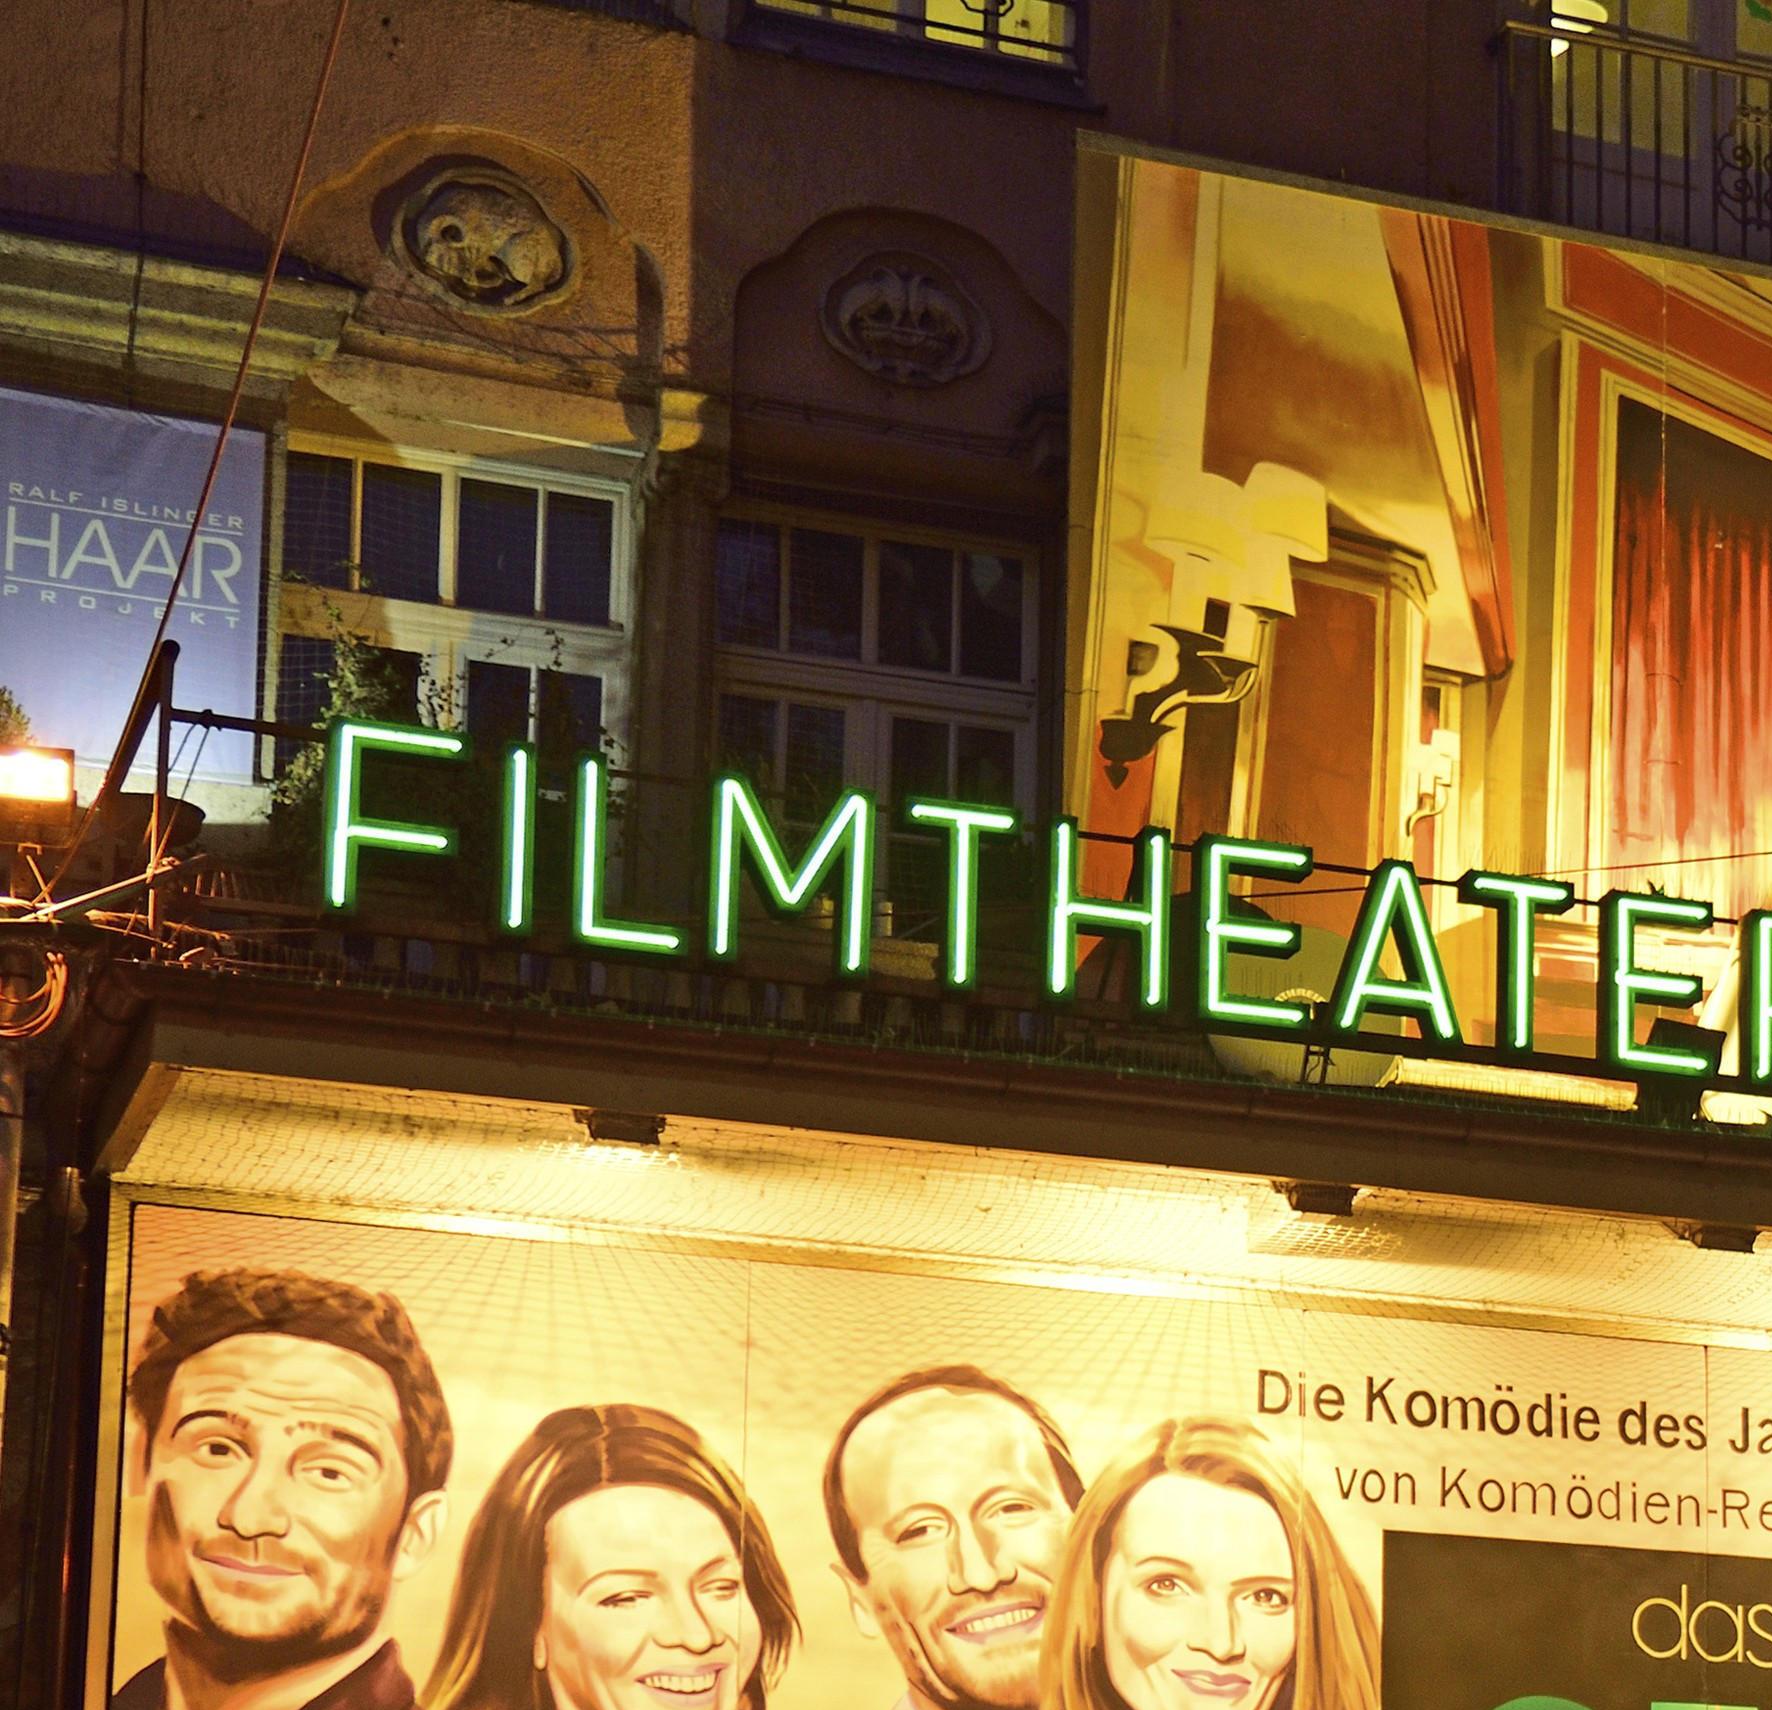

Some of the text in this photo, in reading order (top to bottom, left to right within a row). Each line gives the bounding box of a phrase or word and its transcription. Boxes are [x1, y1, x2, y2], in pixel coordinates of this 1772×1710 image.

[9, 482, 245, 530] RALF ISLINGER
[4, 505, 243, 605] HAAR
[3, 583, 241, 629] PROJEKT
[1256, 1369, 1345, 1423] Die
[1364, 1376, 1603, 1443] Komödie
[1617, 1398, 1709, 1452] des
[1334, 1465, 1417, 1507] von
